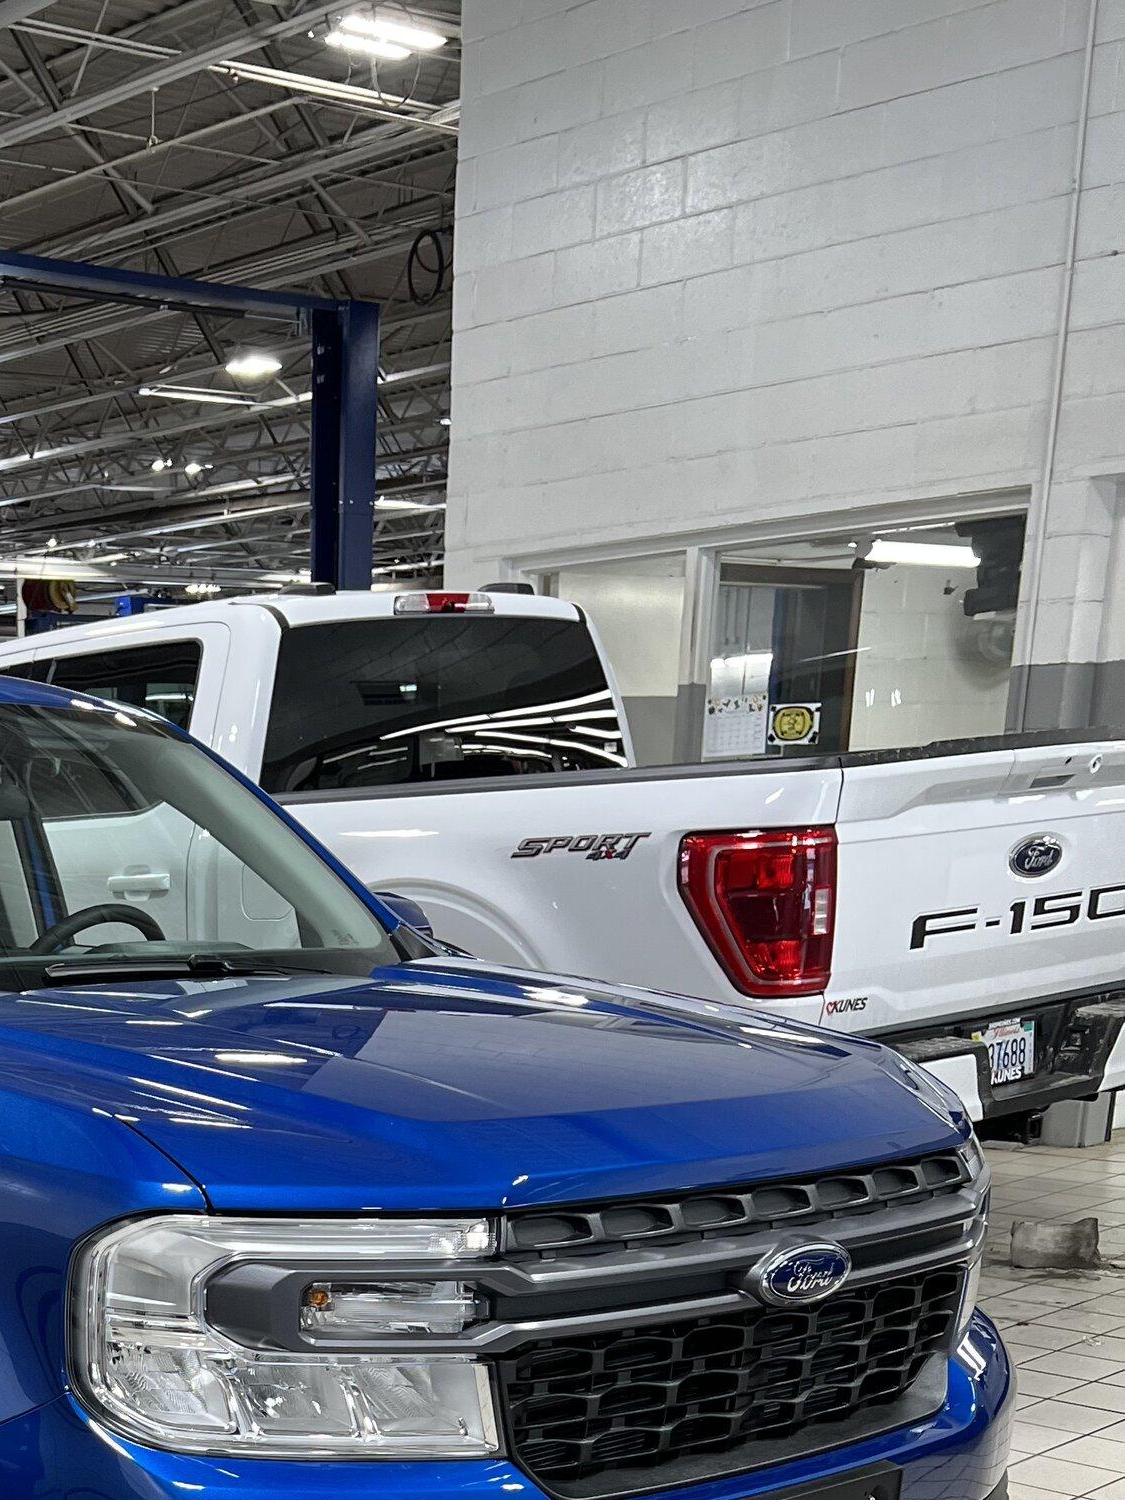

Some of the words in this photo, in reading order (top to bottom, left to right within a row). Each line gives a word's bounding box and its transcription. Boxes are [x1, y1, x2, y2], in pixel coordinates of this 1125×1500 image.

[510, 832, 653, 859] SPORT
[1024, 845, 1055, 870] Ford
[832, 996, 869, 1013] KUNES
[990, 1065, 1023, 1086] KUNES
[786, 1258, 835, 1293] Ford
